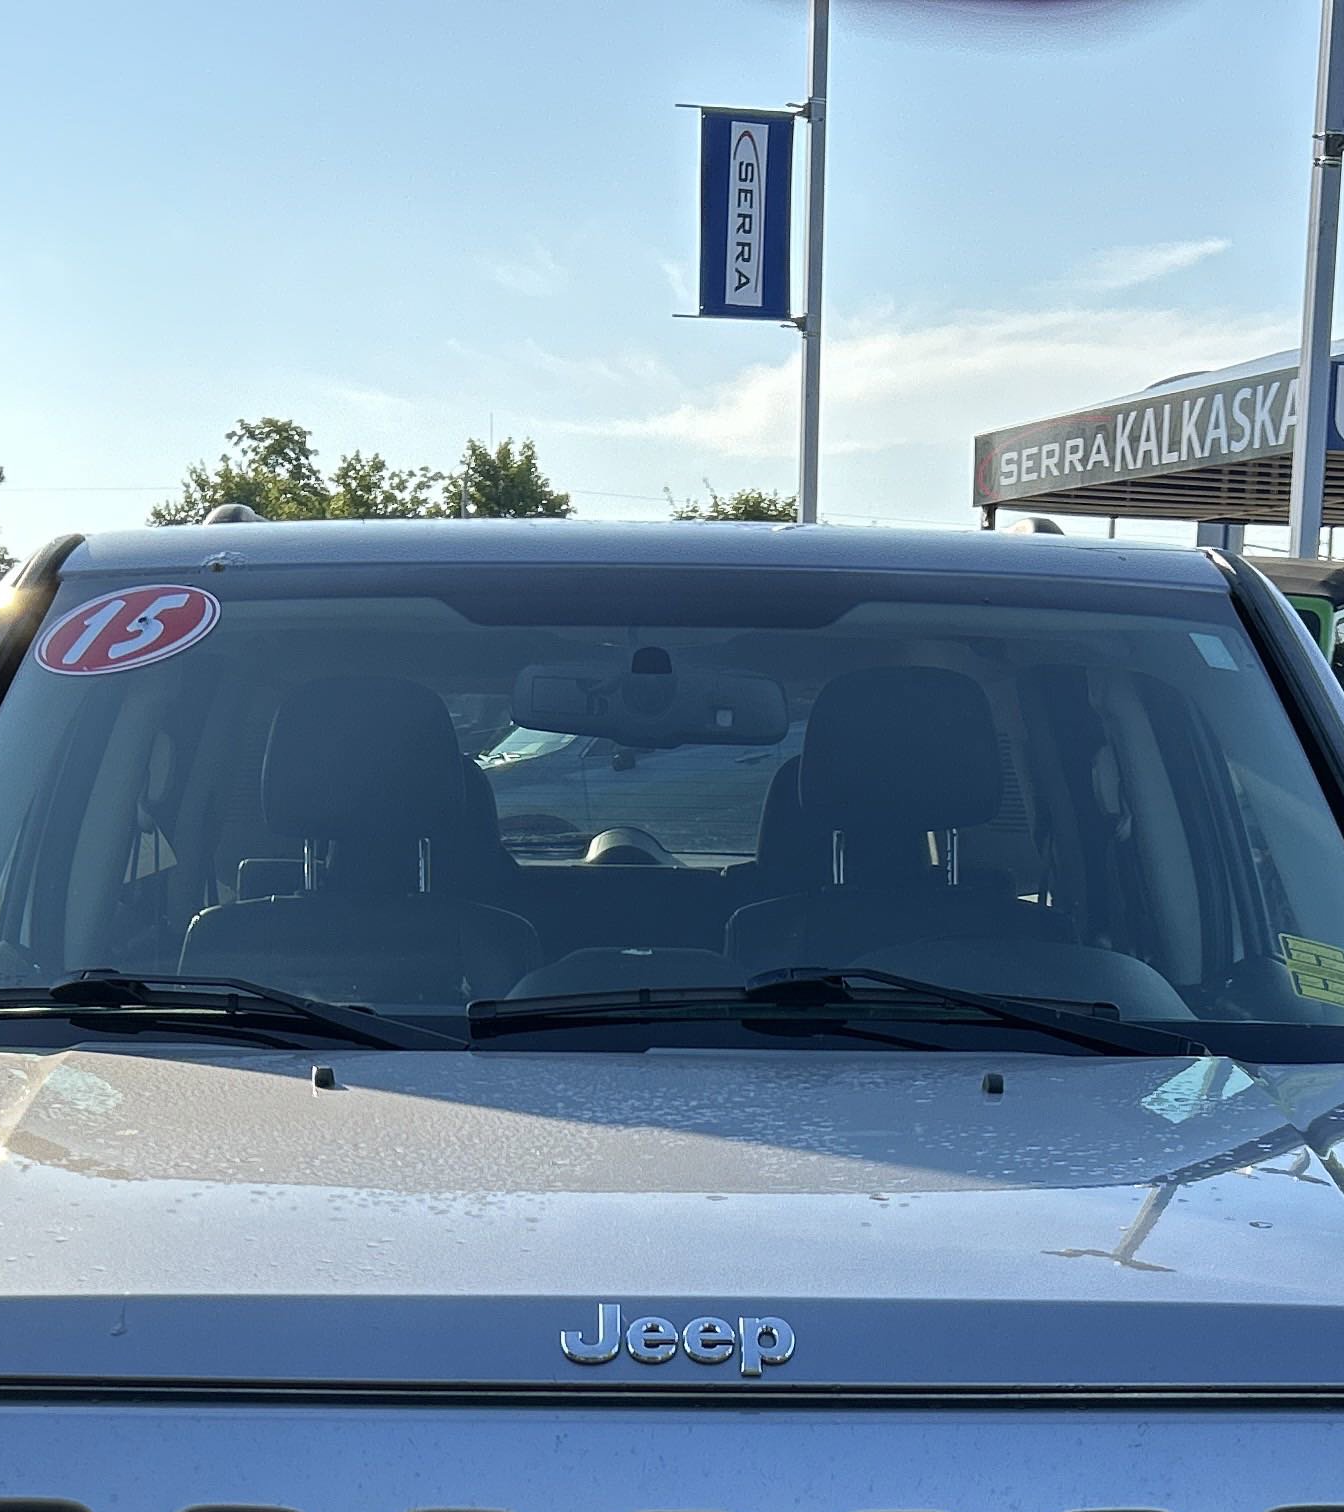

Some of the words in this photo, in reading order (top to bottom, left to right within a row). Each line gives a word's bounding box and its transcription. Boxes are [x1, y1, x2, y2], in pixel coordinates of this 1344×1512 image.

[734, 159, 754, 293] SERRA
[999, 433, 1110, 486] SERRA
[1113, 377, 1301, 473] KALKASKA
[62, 592, 190, 665] 15
[560, 1303, 796, 1377] Jeep
